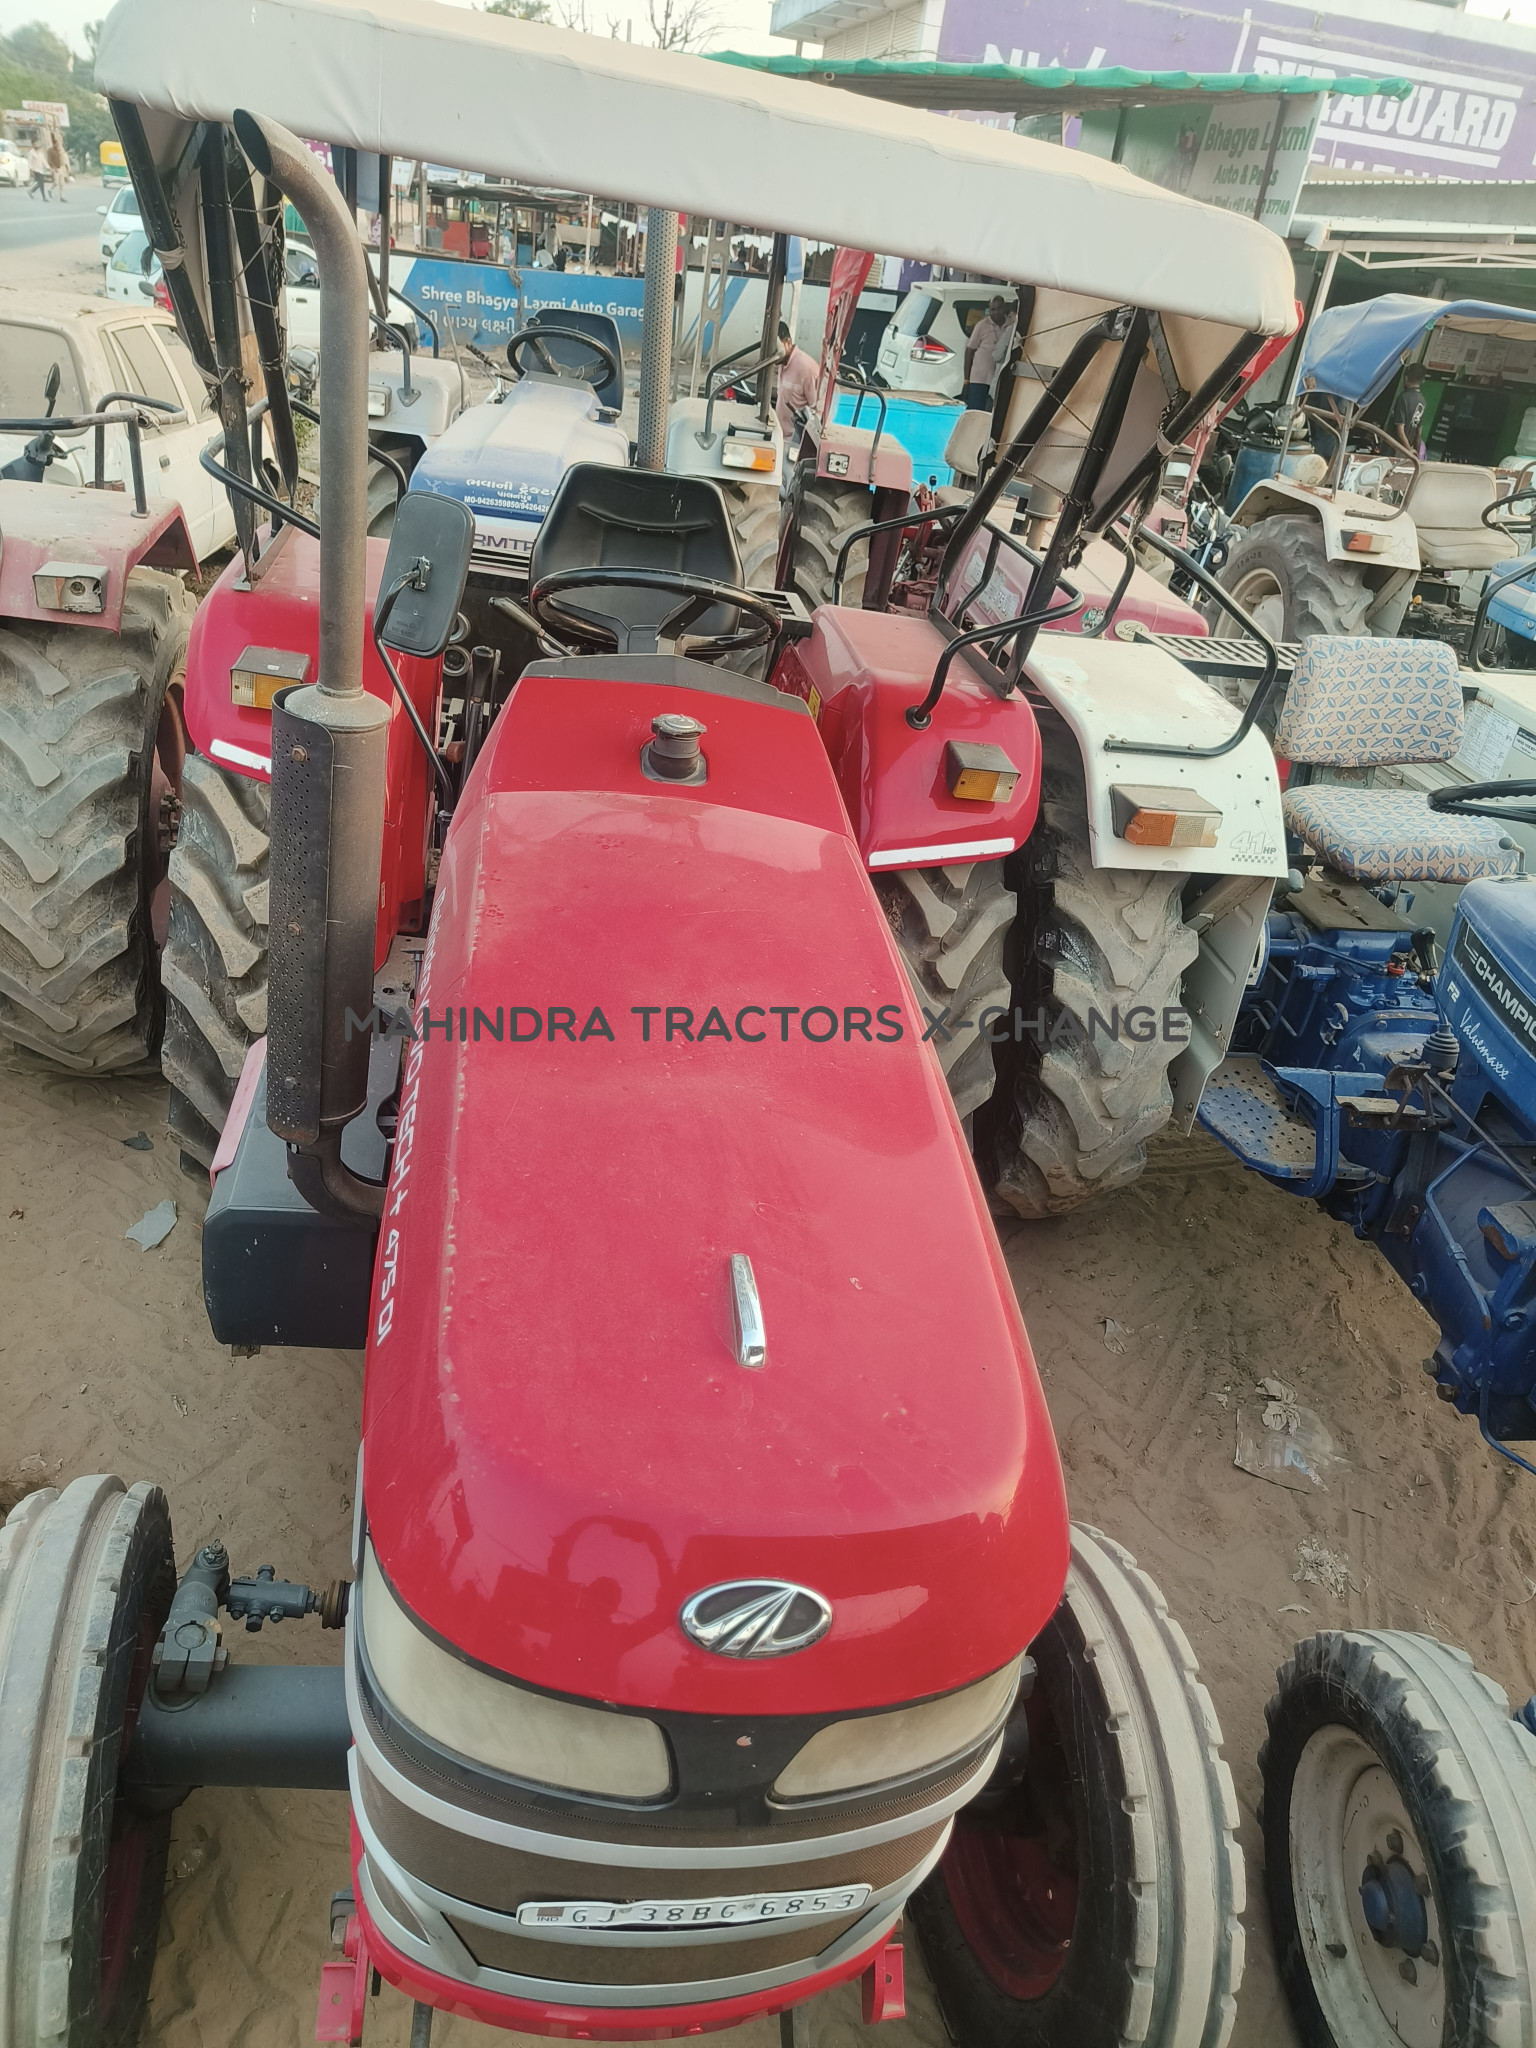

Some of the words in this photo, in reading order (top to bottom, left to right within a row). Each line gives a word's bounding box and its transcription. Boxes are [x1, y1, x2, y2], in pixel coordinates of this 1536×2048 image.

[1253, 55, 1517, 151] AGUARD
[1204, 121, 1260, 158] Bhagya
[1260, 117, 1315, 151] Lxmi
[1213, 164, 1239, 184] Auto
[421, 286, 462, 304] Shree
[466, 290, 518, 311] Bhagya
[523, 295, 566, 310] Laxmi
[570, 299, 603, 314] Auto
[606, 302, 645, 322] Garag
[1263, 846, 1277, 855] HP
[1447, 980, 1461, 1003] F2
[381, 1228, 399, 1301] 475
[376, 1298, 395, 1347] DI
